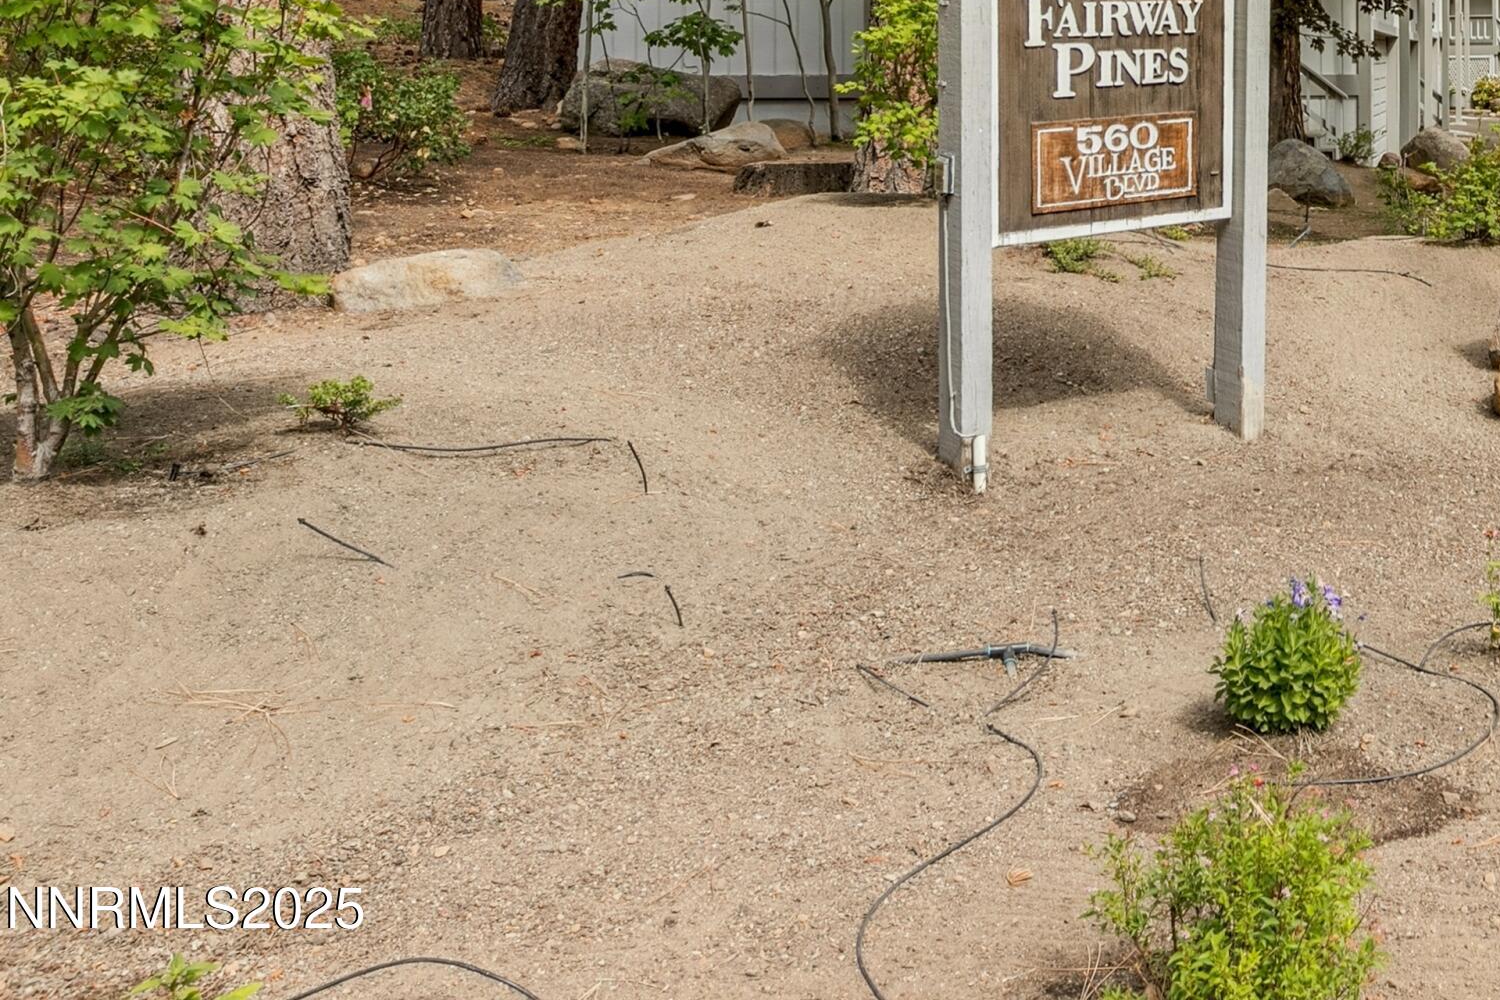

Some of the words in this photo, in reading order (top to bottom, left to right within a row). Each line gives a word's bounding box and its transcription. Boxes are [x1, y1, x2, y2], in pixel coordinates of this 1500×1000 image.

[1052, 42, 1190, 99] PINES
[1076, 121, 1159, 154] 560
[1060, 146, 1177, 195] VILLAGE
[1104, 172, 1160, 200] BLVD
